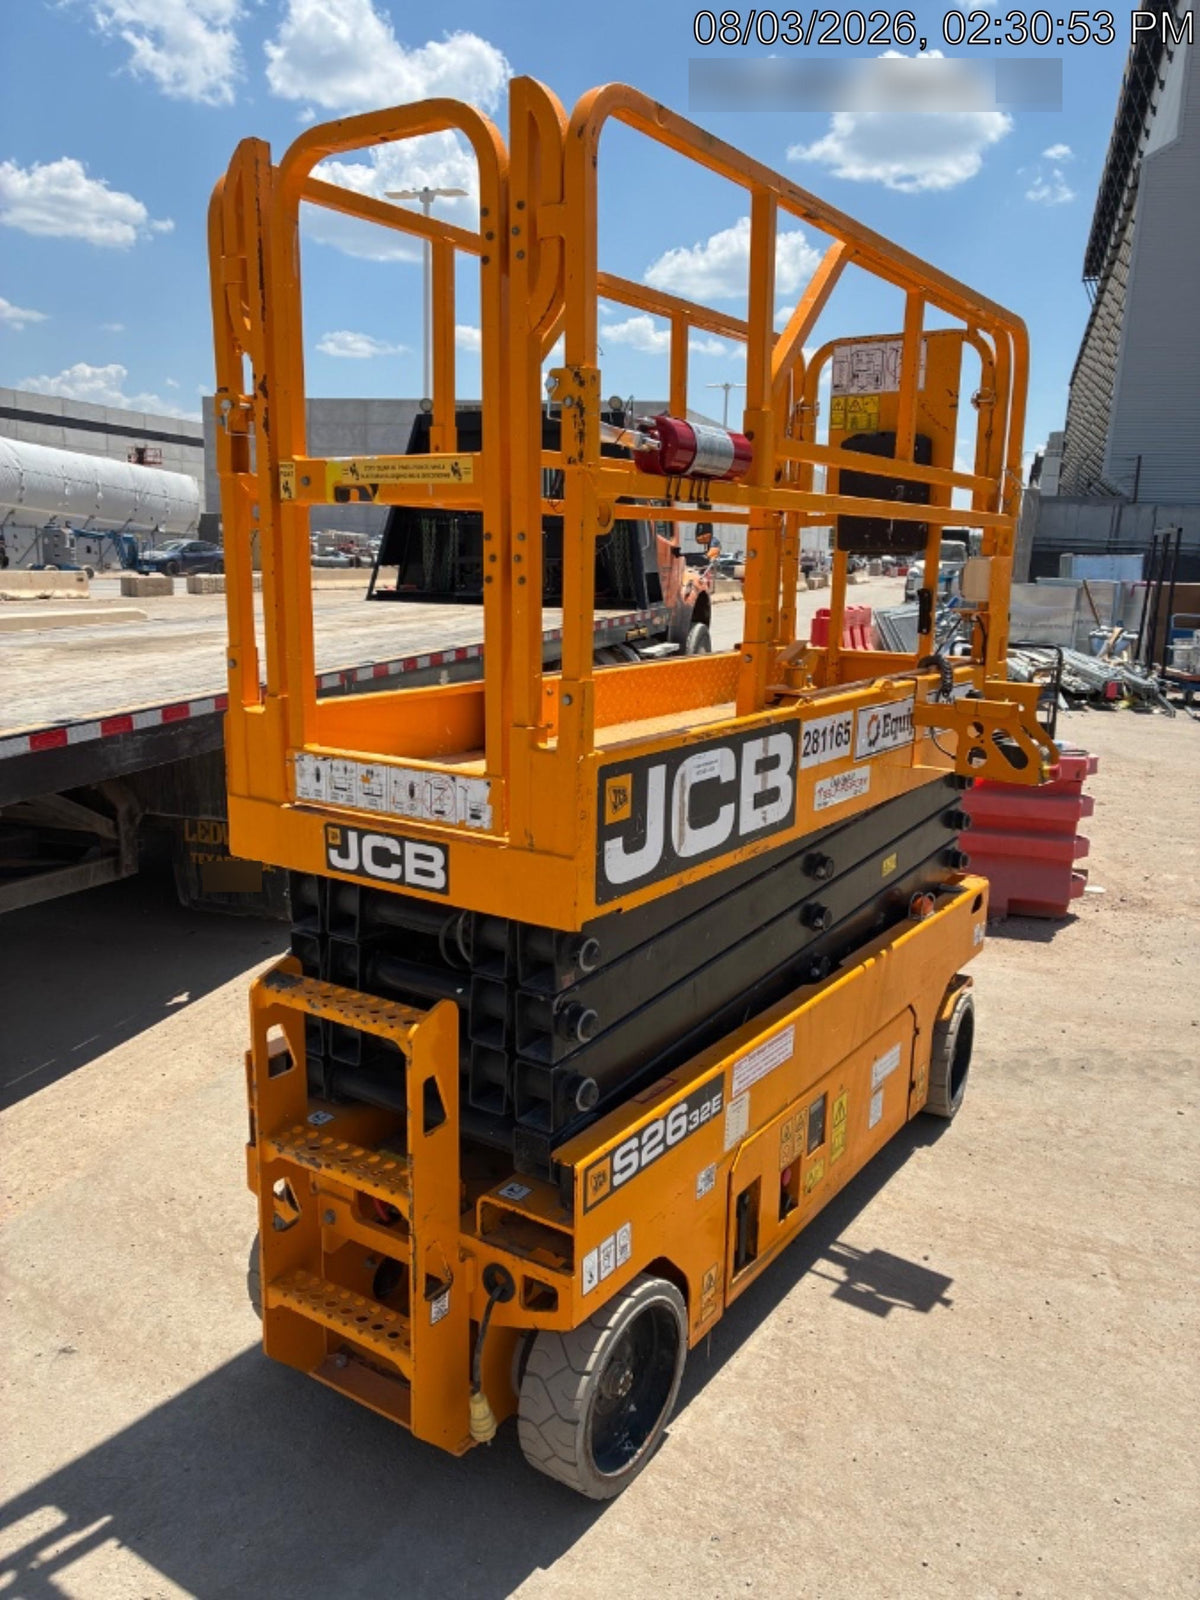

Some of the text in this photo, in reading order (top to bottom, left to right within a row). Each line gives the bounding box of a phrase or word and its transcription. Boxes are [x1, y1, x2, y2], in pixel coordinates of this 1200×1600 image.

[802, 721, 852, 758] 281165
[603, 732, 794, 884] JCB
[327, 830, 447, 889] JCB
